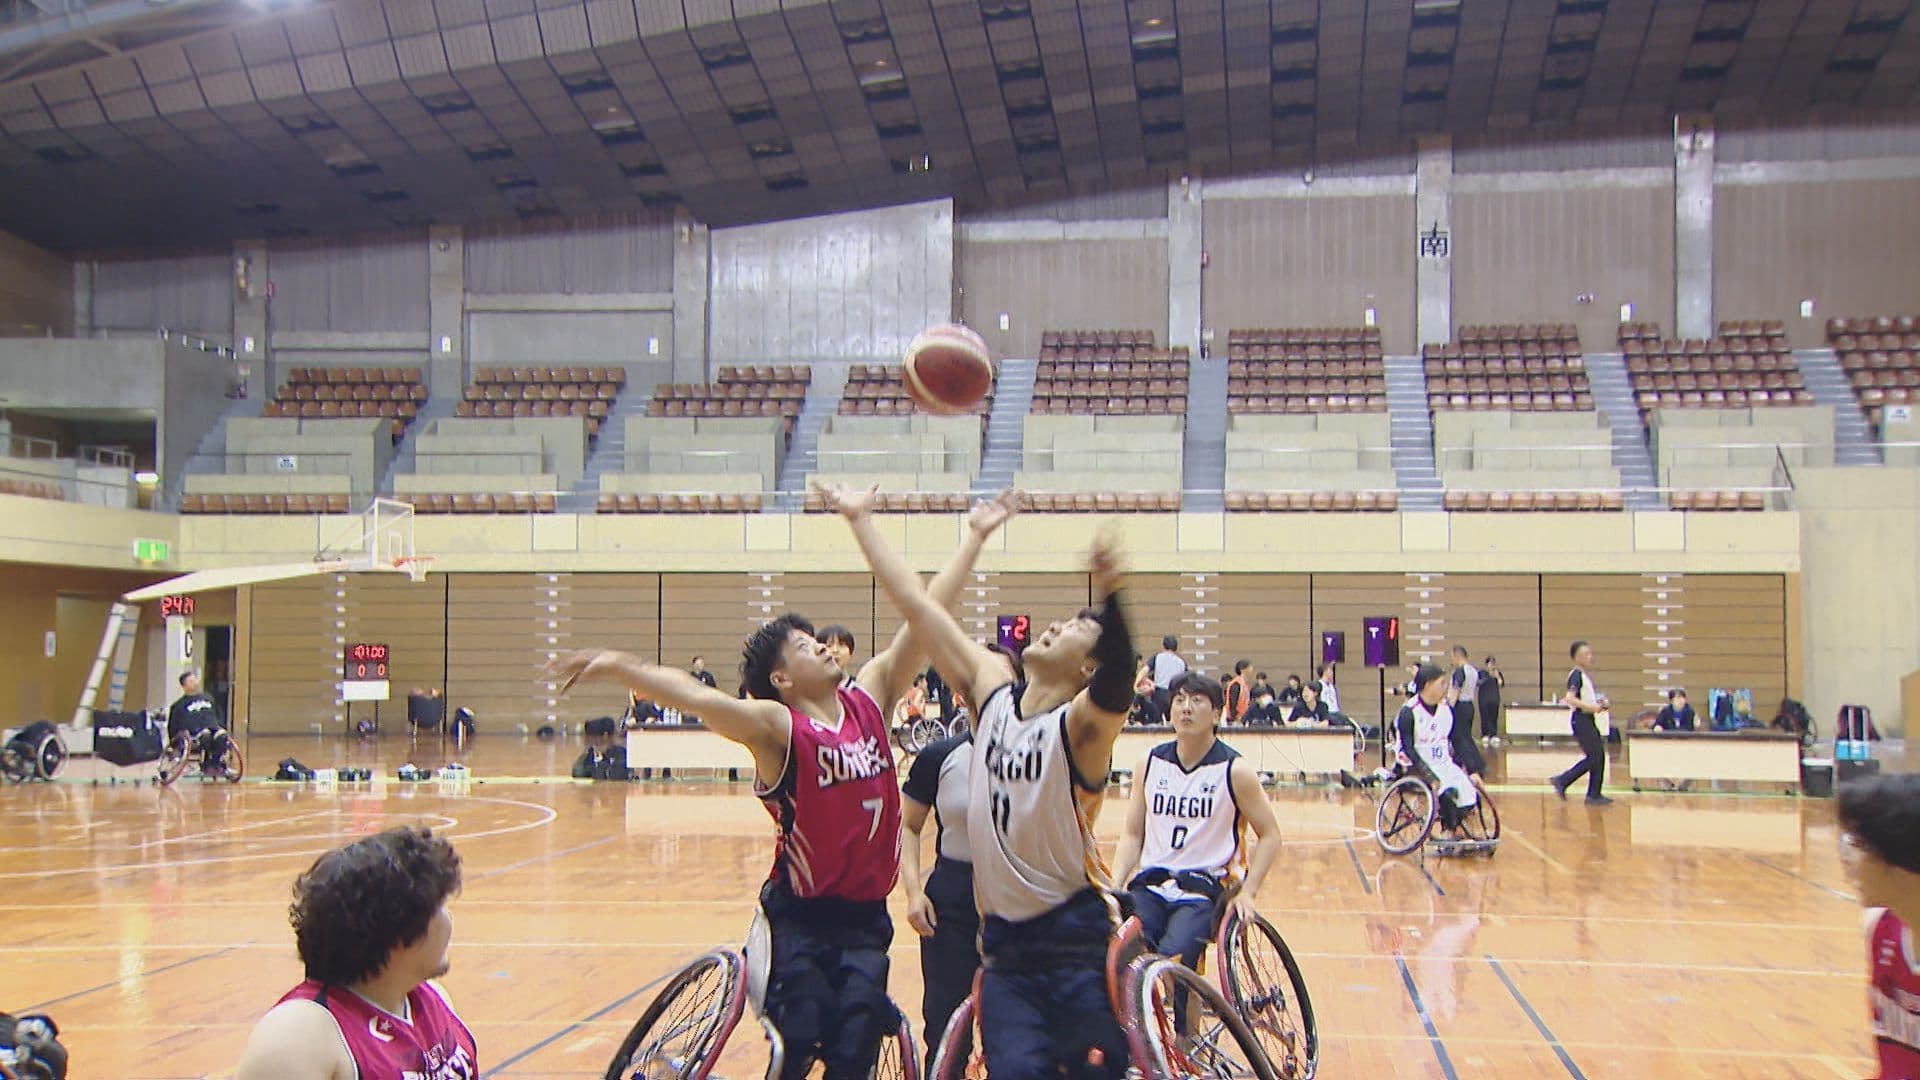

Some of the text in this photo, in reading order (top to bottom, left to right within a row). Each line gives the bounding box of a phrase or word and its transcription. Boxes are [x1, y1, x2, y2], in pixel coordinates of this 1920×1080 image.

[1420, 220, 1448, 257] 南
[1014, 615, 1028, 641] 2
[358, 663, 386, 677] 0 0
[1153, 793, 1212, 818] DAEGU
[861, 797, 884, 842] 7
[1171, 824, 1188, 850] 0
